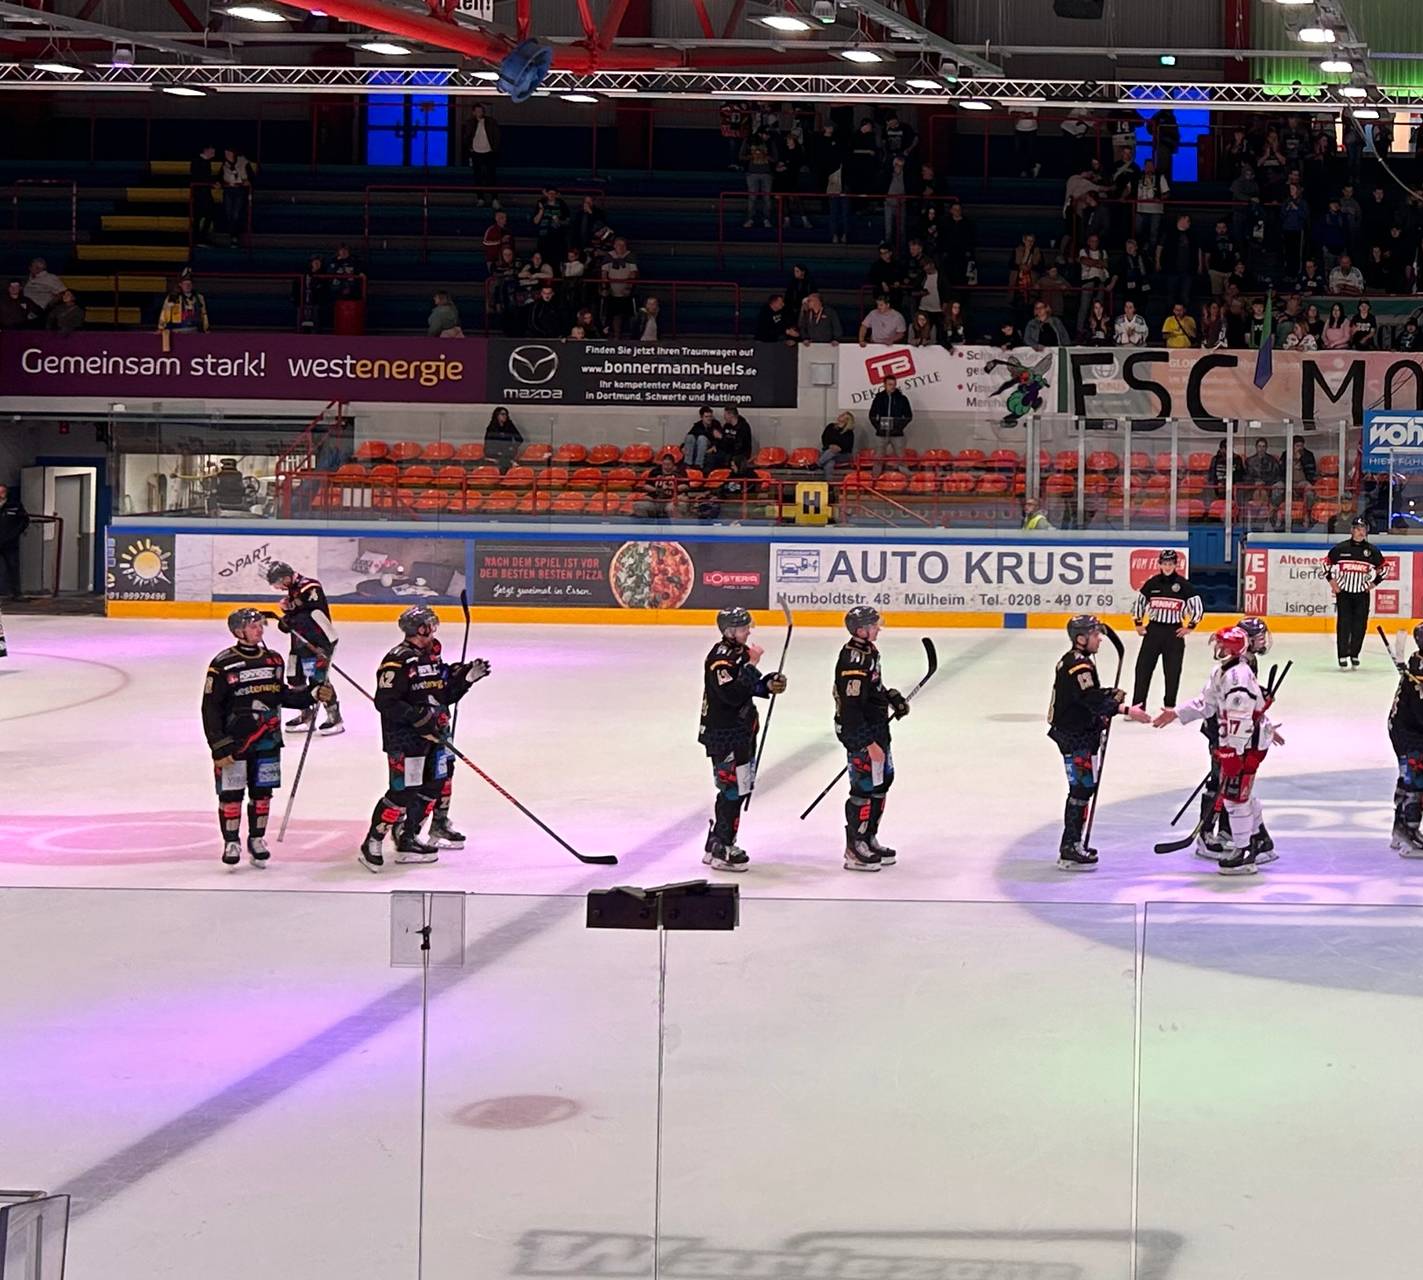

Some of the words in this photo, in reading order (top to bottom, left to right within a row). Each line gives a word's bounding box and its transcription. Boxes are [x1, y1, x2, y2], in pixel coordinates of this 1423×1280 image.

[585, 346, 616, 355] Finden
[617, 346, 632, 355] Sie
[632, 346, 655, 358] jetzt
[657, 347, 680, 356] Ihren
[682, 348, 737, 359] Traumwagen
[738, 348, 754, 357] auf
[22, 349, 181, 375] Gemeinsam
[190, 352, 266, 377] stark!
[288, 354, 463, 387] westenergie
[581, 359, 757, 376] www.bonnermann-huels.de
[600, 380, 613, 389] Ihr
[614, 381, 671, 391] kompetenter
[672, 381, 702, 390] Mazda
[704, 382, 738, 391] Partner
[904, 371, 942, 391] STYLE
[586, 391, 594, 400] in
[645, 392, 687, 402] Schwerte
[689, 393, 705, 401] und
[708, 394, 751, 404] Hattingen
[484, 557, 510, 568] NACH
[512, 557, 532, 568] DEM
[534, 557, 561, 568] SPIEL
[564, 558, 578, 568] IST
[581, 558, 599, 569] VOR
[826, 551, 949, 584] AUTO
[966, 551, 1114, 585] KRUSE
[480, 568, 498, 578] DER
[501, 568, 535, 579] BESTEN
[539, 569, 573, 579] BESTEN
[575, 570, 603, 580] PIZZA
[776, 592, 868, 606] Humboldtstr.
[873, 592, 890, 606] 48
[904, 591, 966, 607] Mülheim
[1007, 593, 1043, 607] 0208
[1054, 593, 1072, 607] 49
[1075, 593, 1094, 607] 07
[1096, 594, 1114, 607] 69
[1285, 602, 1328, 616] Isinger
